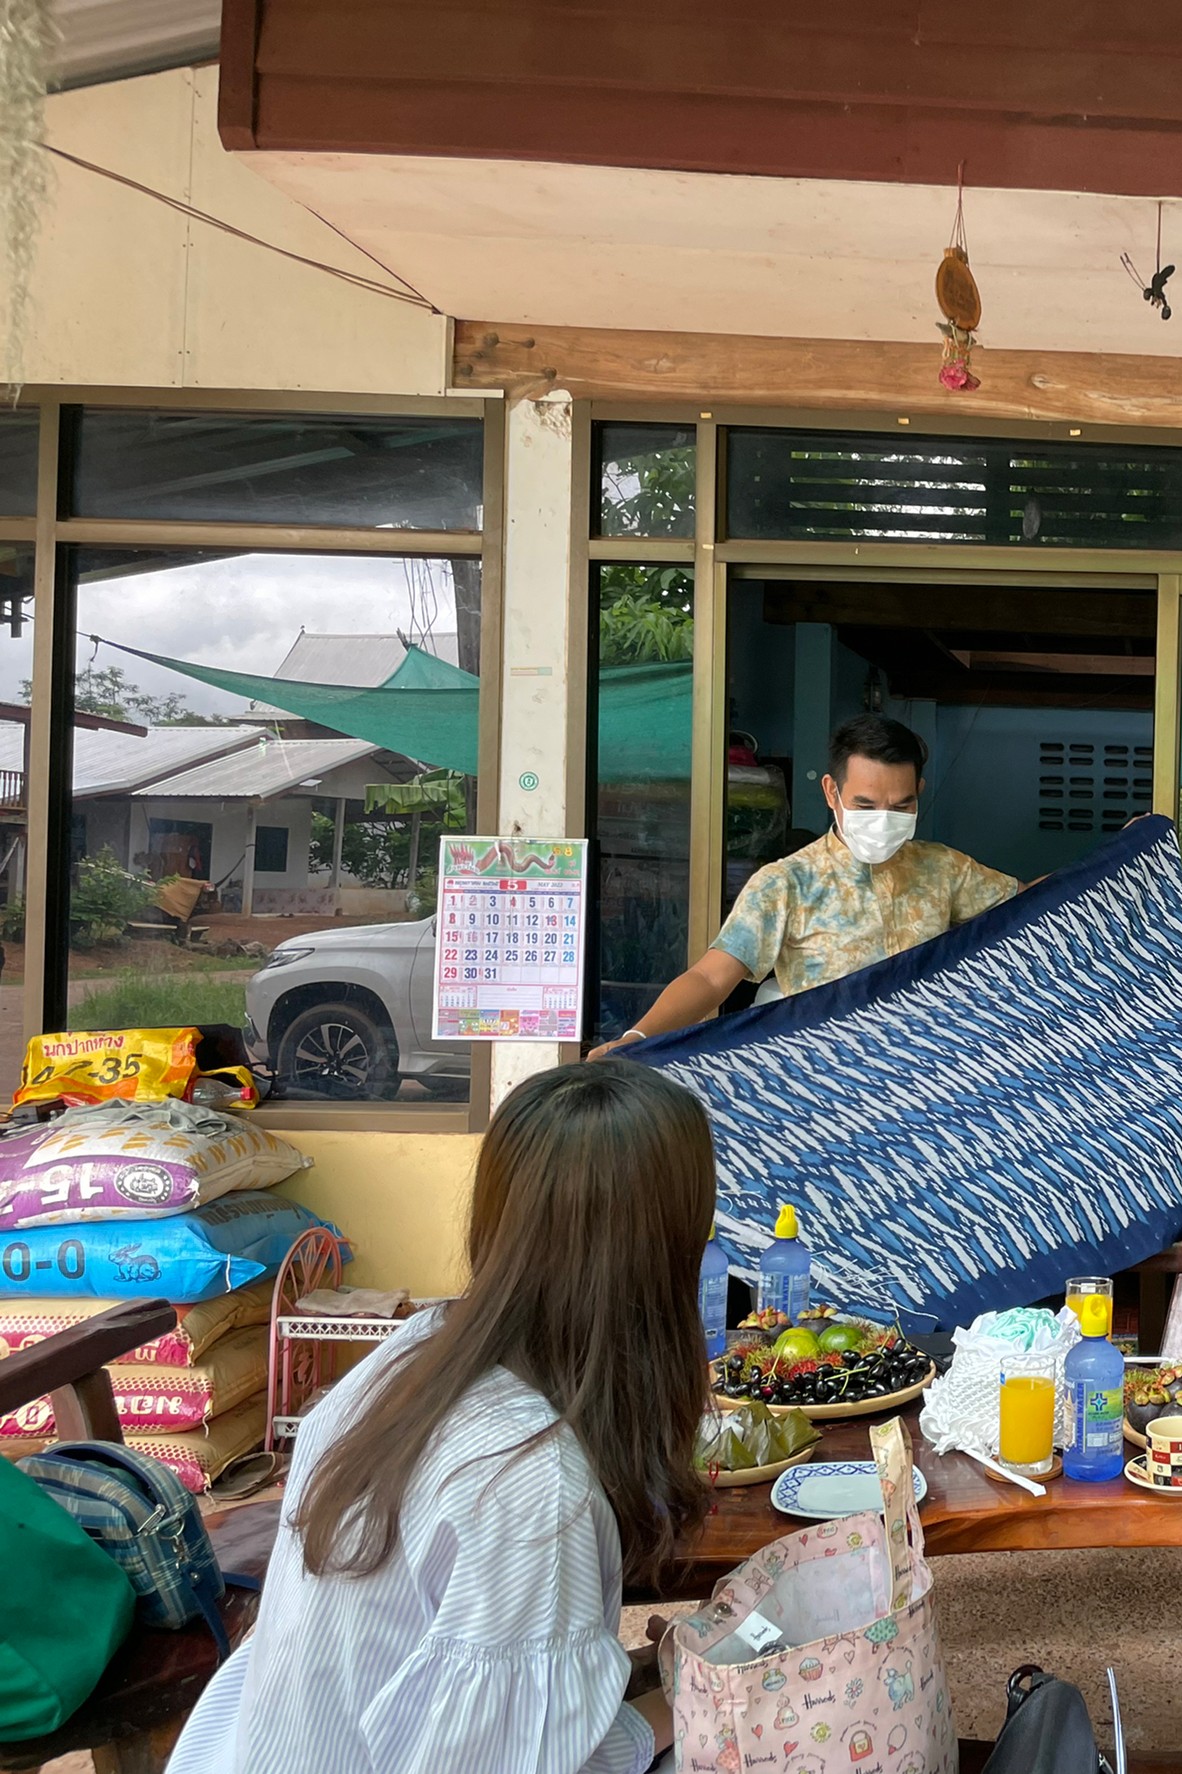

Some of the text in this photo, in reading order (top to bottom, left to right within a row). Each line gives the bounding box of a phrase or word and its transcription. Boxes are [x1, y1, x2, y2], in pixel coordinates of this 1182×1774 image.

[508, 880, 518, 891] 5
[451, 895, 456, 906] 1
[490, 896, 496, 907] 3
[529, 897, 536, 908] 5
[548, 897, 555, 908] 6
[567, 898, 573, 908] 7
[449, 913, 576, 926] 8 9 10 11 12 13 14
[446, 931, 458, 942] 15
[486, 932, 499, 943] 17
[506, 933, 519, 944] 18
[526, 933, 538, 944] 19
[544, 933, 557, 944] 20
[563, 934, 574, 945] 21
[445, 949, 575, 962] 22 23 24 25 26 27 28
[444, 967, 497, 979] 29 30 31
[2, 1239, 86, 1282] 0-0
